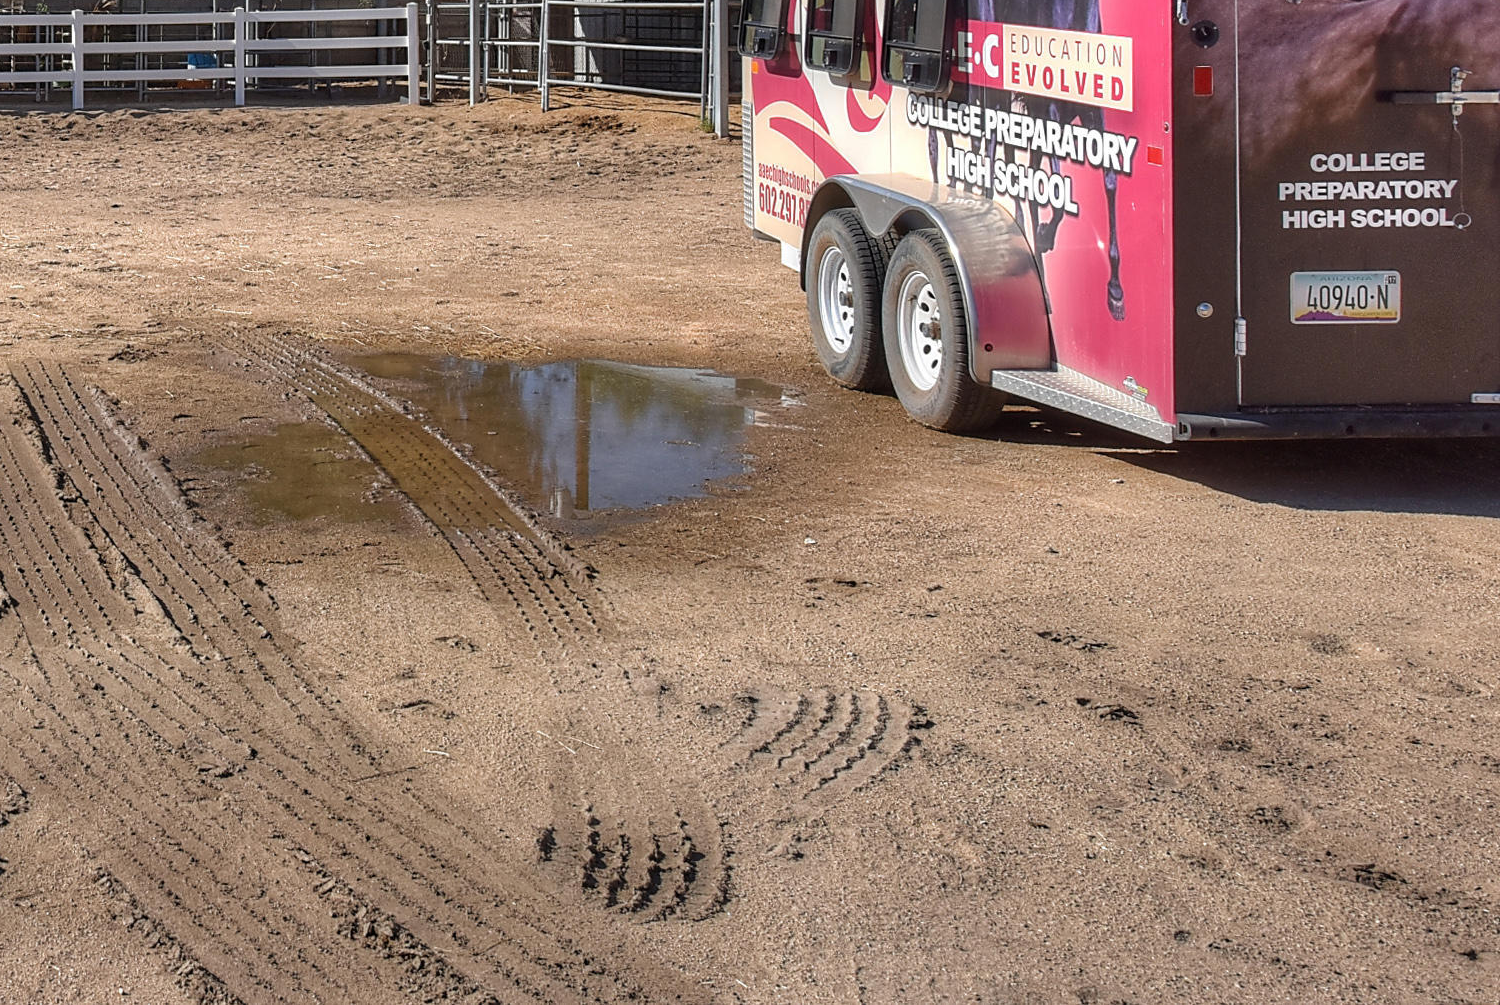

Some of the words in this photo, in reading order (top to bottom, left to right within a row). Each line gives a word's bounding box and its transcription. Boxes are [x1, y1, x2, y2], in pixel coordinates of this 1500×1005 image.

[1010, 33, 1123, 68] EDUCATION
[1011, 61, 1124, 102] EVOLVED
[907, 93, 982, 137] COLLEGE
[985, 109, 1138, 174] PREPARATORY
[1310, 152, 1426, 172] COLLEGE
[947, 147, 991, 189] HIGH
[994, 159, 1079, 214] SCHOOL
[1279, 179, 1458, 201] PREPARATORY
[1282, 209, 1346, 229] HIGH
[1350, 208, 1455, 229] SCHOOL
